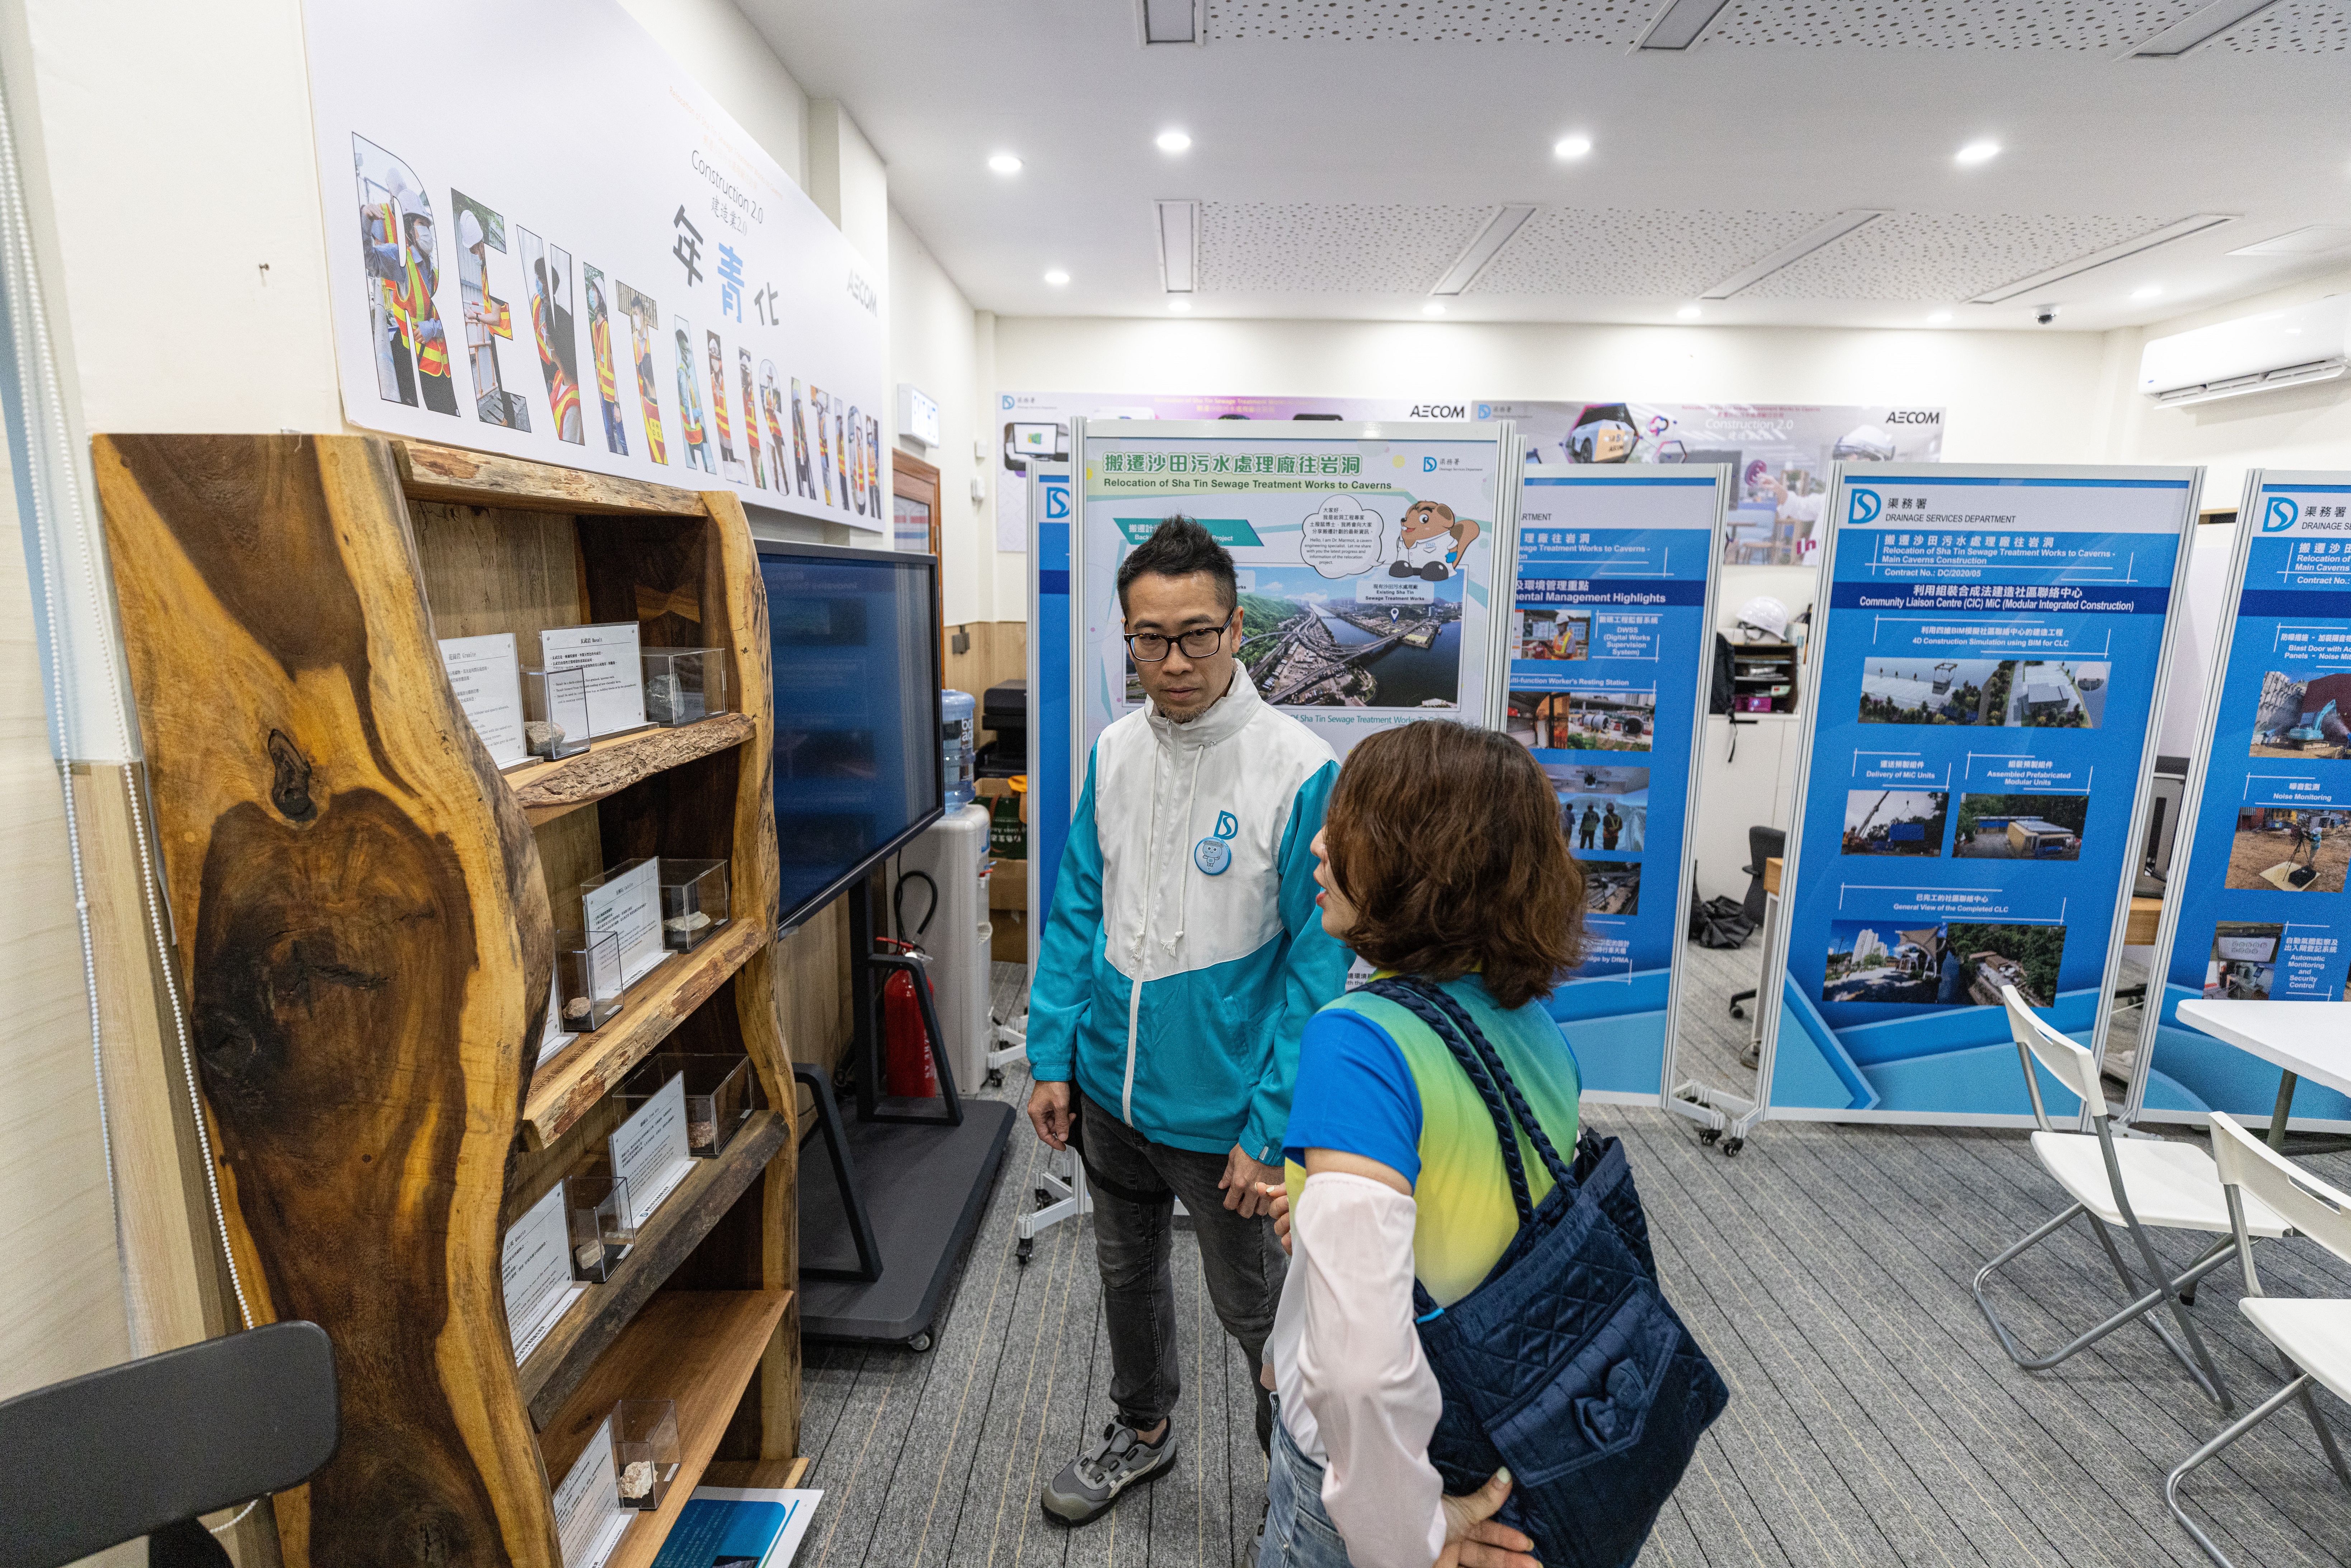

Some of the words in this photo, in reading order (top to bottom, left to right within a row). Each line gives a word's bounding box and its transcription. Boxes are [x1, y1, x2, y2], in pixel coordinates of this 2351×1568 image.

[692, 150, 749, 213] Construction
[751, 200, 763, 224] 2.0
[847, 268, 878, 318] AECOM
[351, 131, 882, 520] REVITALISATION
[1409, 405, 1465, 419] AECOM
[1885, 411, 1940, 425] AECOM
[1104, 453, 1362, 474] 搬遷沙田污水處理廠往岩洞
[1104, 478, 1156, 487] Relocation
[1159, 479, 1169, 487] of
[1172, 479, 1190, 487] Sha
[1193, 480, 1208, 488] Tin
[1211, 480, 1249, 490] Sewage
[1253, 480, 1302, 488] Treatment
[1305, 480, 1335, 489] Works
[1351, 481, 1391, 490] Caverns
[1887, 497, 1927, 510] 渠務署
[2304, 506, 2346, 518] 渠務署
[1885, 514, 1924, 523] DRAINAGE
[1926, 514, 1963, 523] SERVICES
[1965, 515, 2016, 524] DEPARTMENT
[1883, 546, 1925, 555] Relocation
[1967, 548, 1998, 557] Sewage
[1999, 548, 2039, 556] Treatment
[2078, 549, 2110, 557] Caverns
[1937, 556, 1987, 565] Construction
[1885, 568, 1918, 576] Contract
[1920, 568, 1935, 577] No.:
[1937, 569, 1982, 577] DC/2020/05
[1545, 592, 1611, 603] Management
[1613, 593, 1666, 604] Highlights
[1860, 596, 1904, 609] Community
[1906, 597, 1934, 607] Liaison
[1936, 598, 1962, 608] Centre
[2002, 598, 2038, 610] (Modular
[2039, 599, 2079, 611] Integrated
[2080, 600, 2134, 613] Construction)
[1579, 678, 1604, 686] Resting
[1328, 715, 1354, 725] Sewage
[1866, 770, 1893, 779] Delivery
[2294, 793, 2332, 802] Monitoring
[1957, 905, 1993, 913] Completed
[2288, 961, 2325, 969] Monitoring
